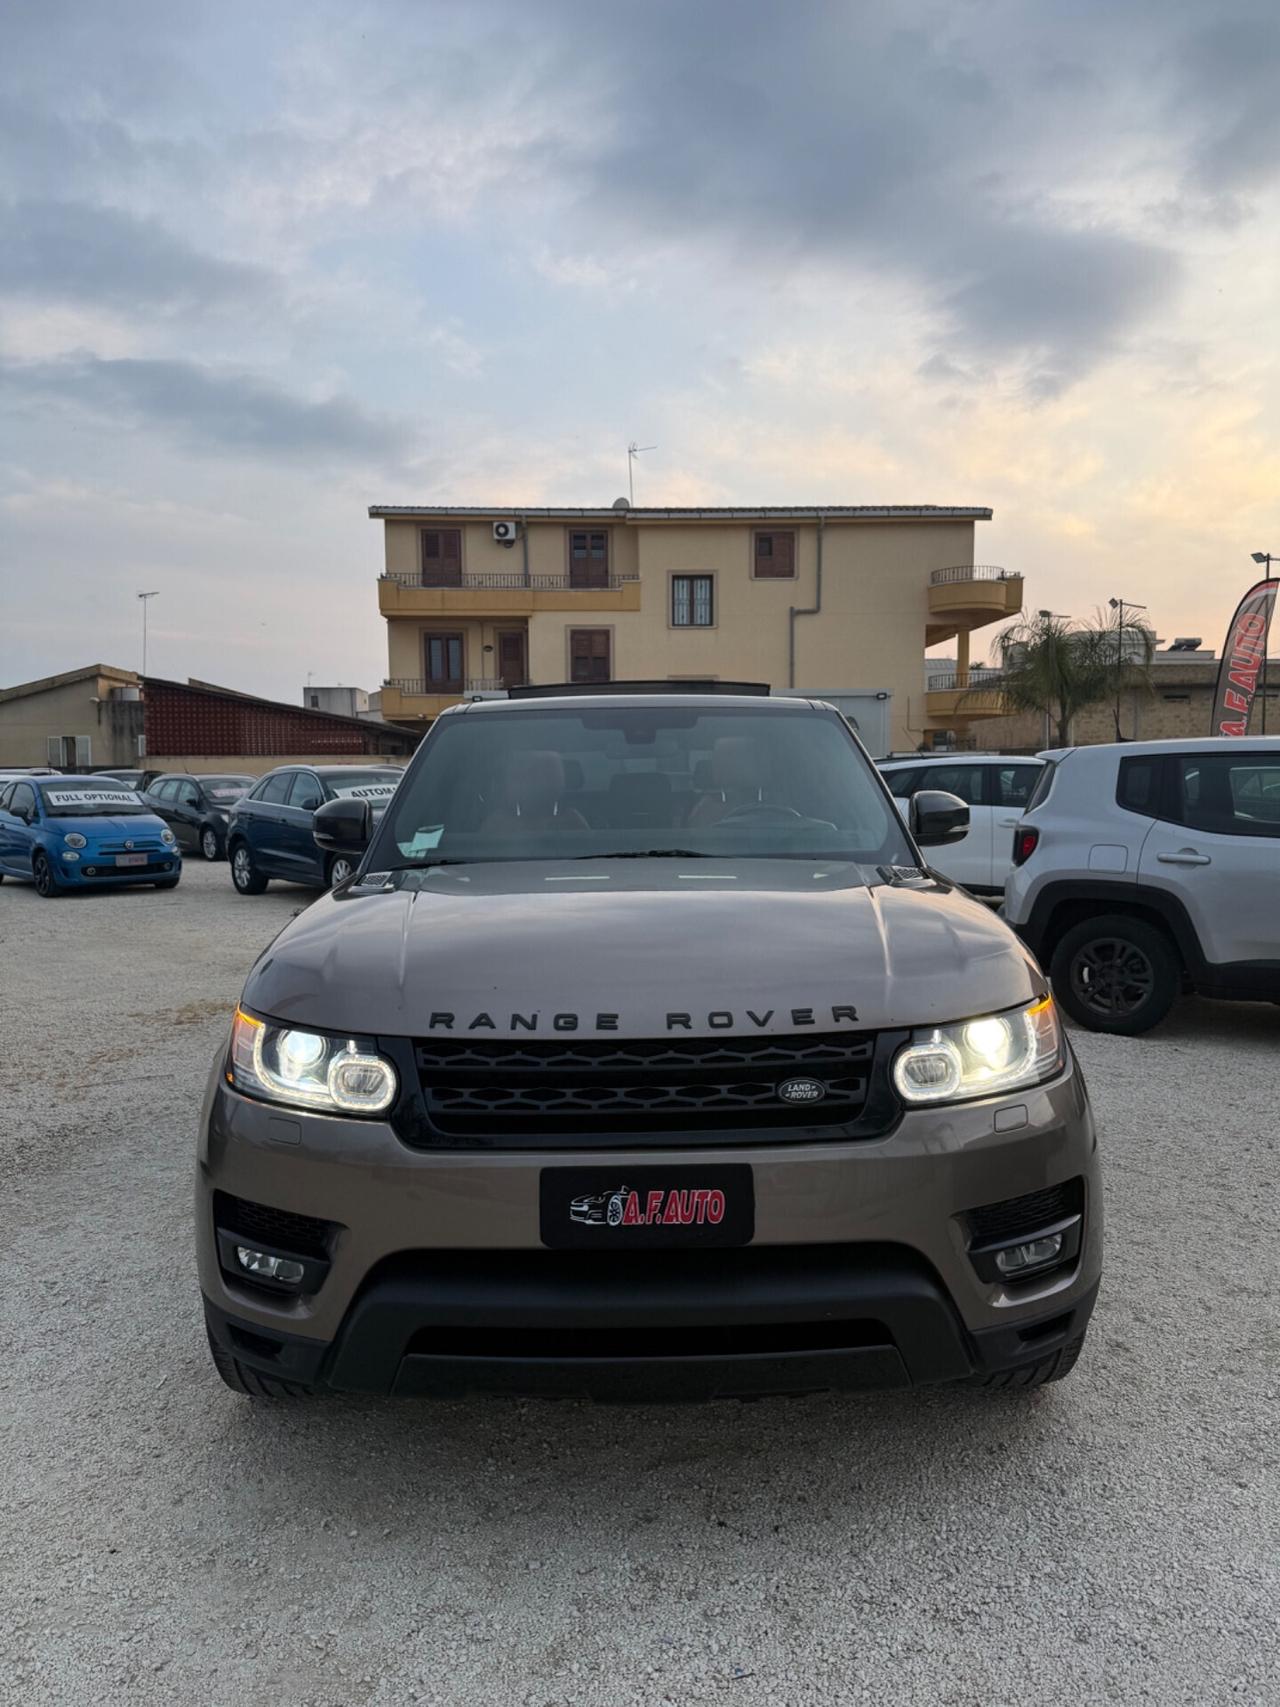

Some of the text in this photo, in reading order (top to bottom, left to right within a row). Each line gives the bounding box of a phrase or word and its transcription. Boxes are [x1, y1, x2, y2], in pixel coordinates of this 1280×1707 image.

[55, 793, 135, 802] FULL OPTIONAL
[429, 1005, 859, 1031] RANGE ROVER
[787, 1084, 811, 1092] LAND
[790, 1091, 819, 1099] ROVER
[621, 1189, 726, 1226] A.F.AUTO
